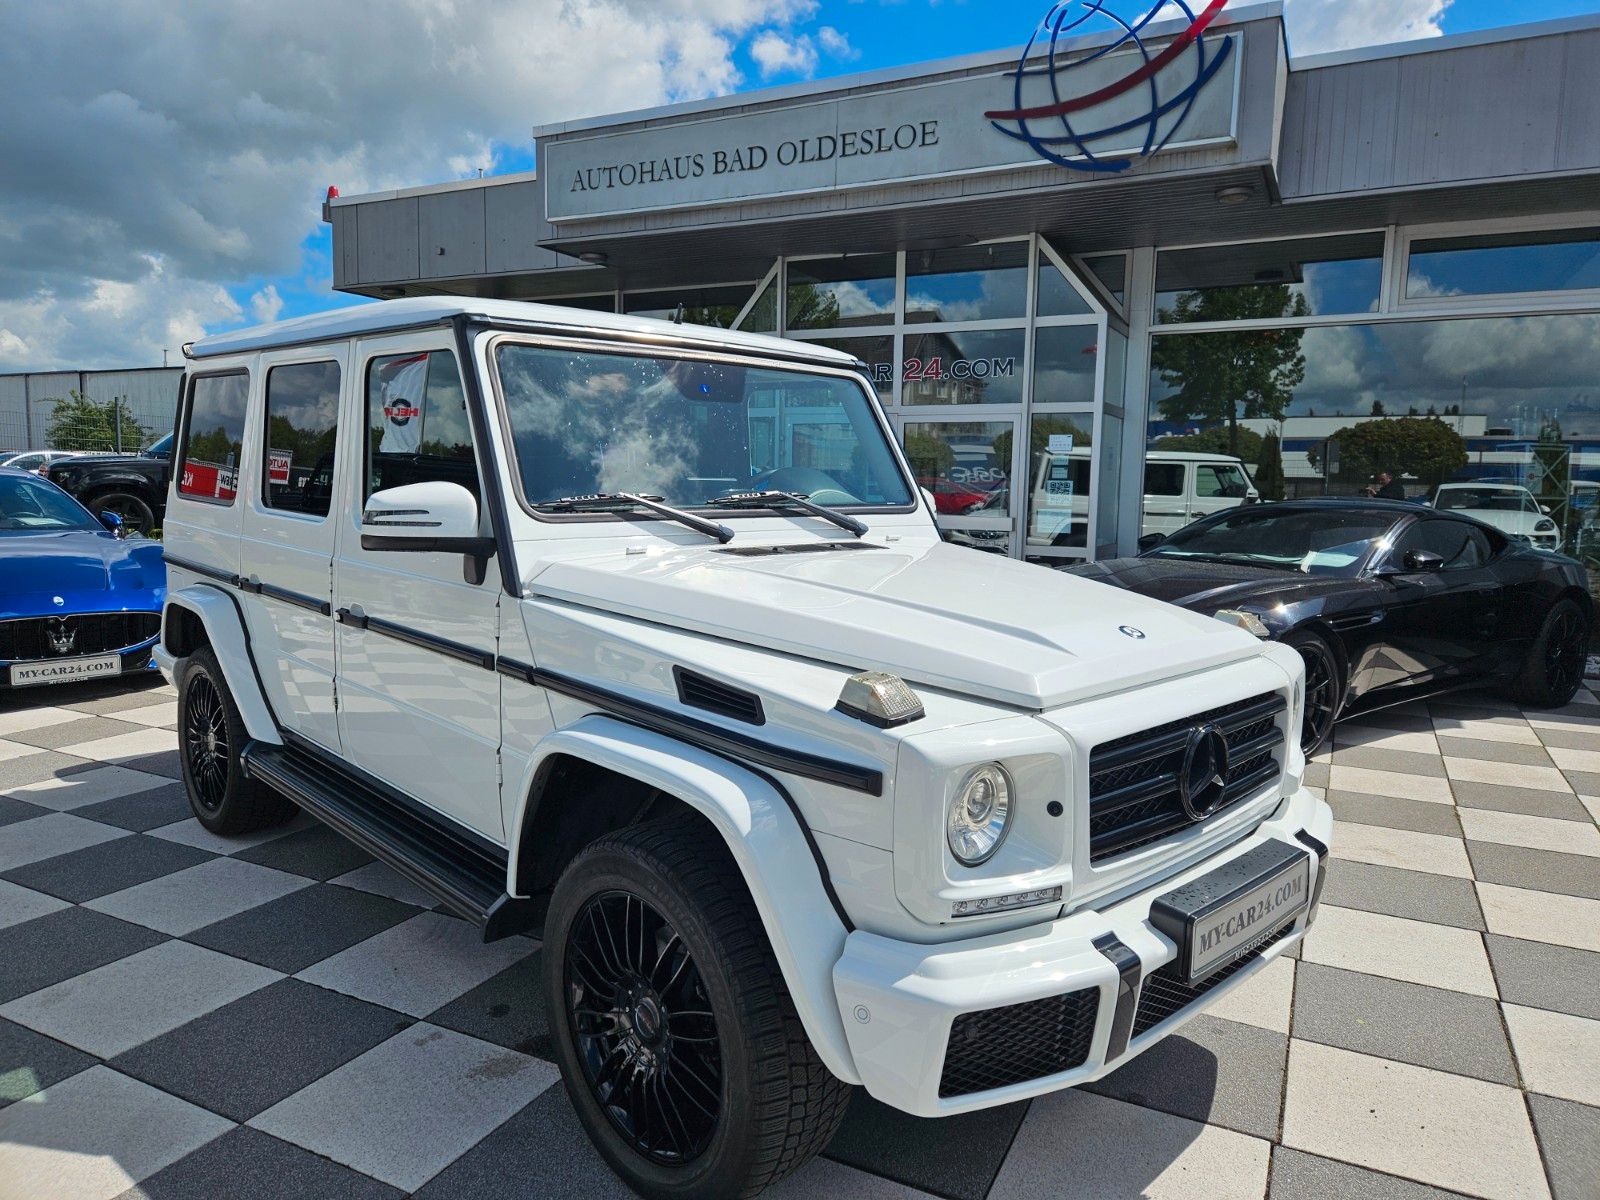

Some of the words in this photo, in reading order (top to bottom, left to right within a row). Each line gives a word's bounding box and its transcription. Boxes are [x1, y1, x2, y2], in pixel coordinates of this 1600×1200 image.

[570, 153, 704, 193] AUTOHAUS
[711, 144, 768, 175] BAD
[776, 119, 940, 167] OLDESLOE
[18, 661, 115, 679] MY-CAR24.COM
[1198, 874, 1303, 955] MY-CAR24.COM
